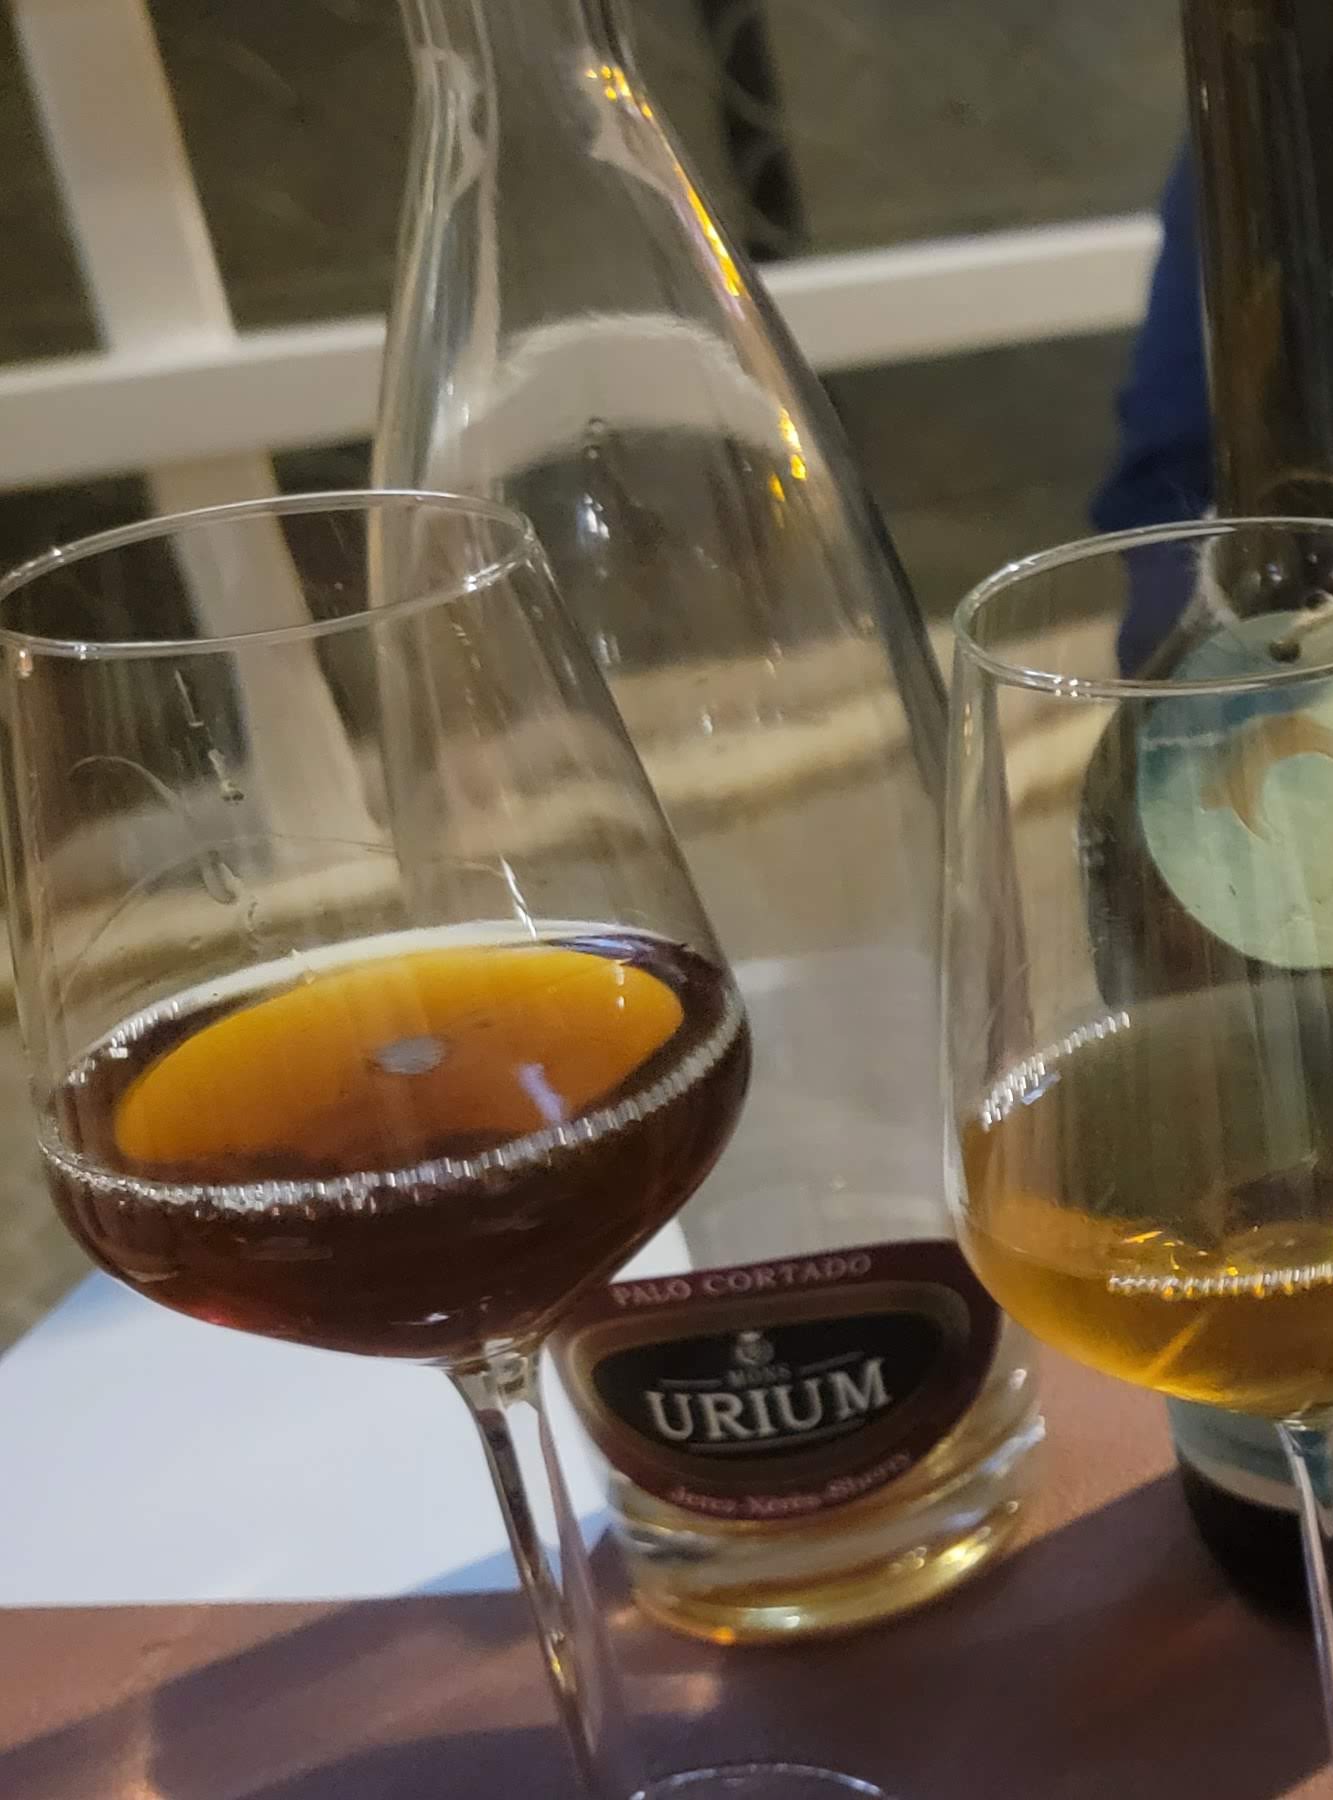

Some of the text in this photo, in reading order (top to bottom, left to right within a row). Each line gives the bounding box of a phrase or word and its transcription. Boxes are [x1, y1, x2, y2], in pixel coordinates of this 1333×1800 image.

[610, 1252, 872, 1306] PALO CORTADO
[644, 1356, 892, 1441] URIUM
